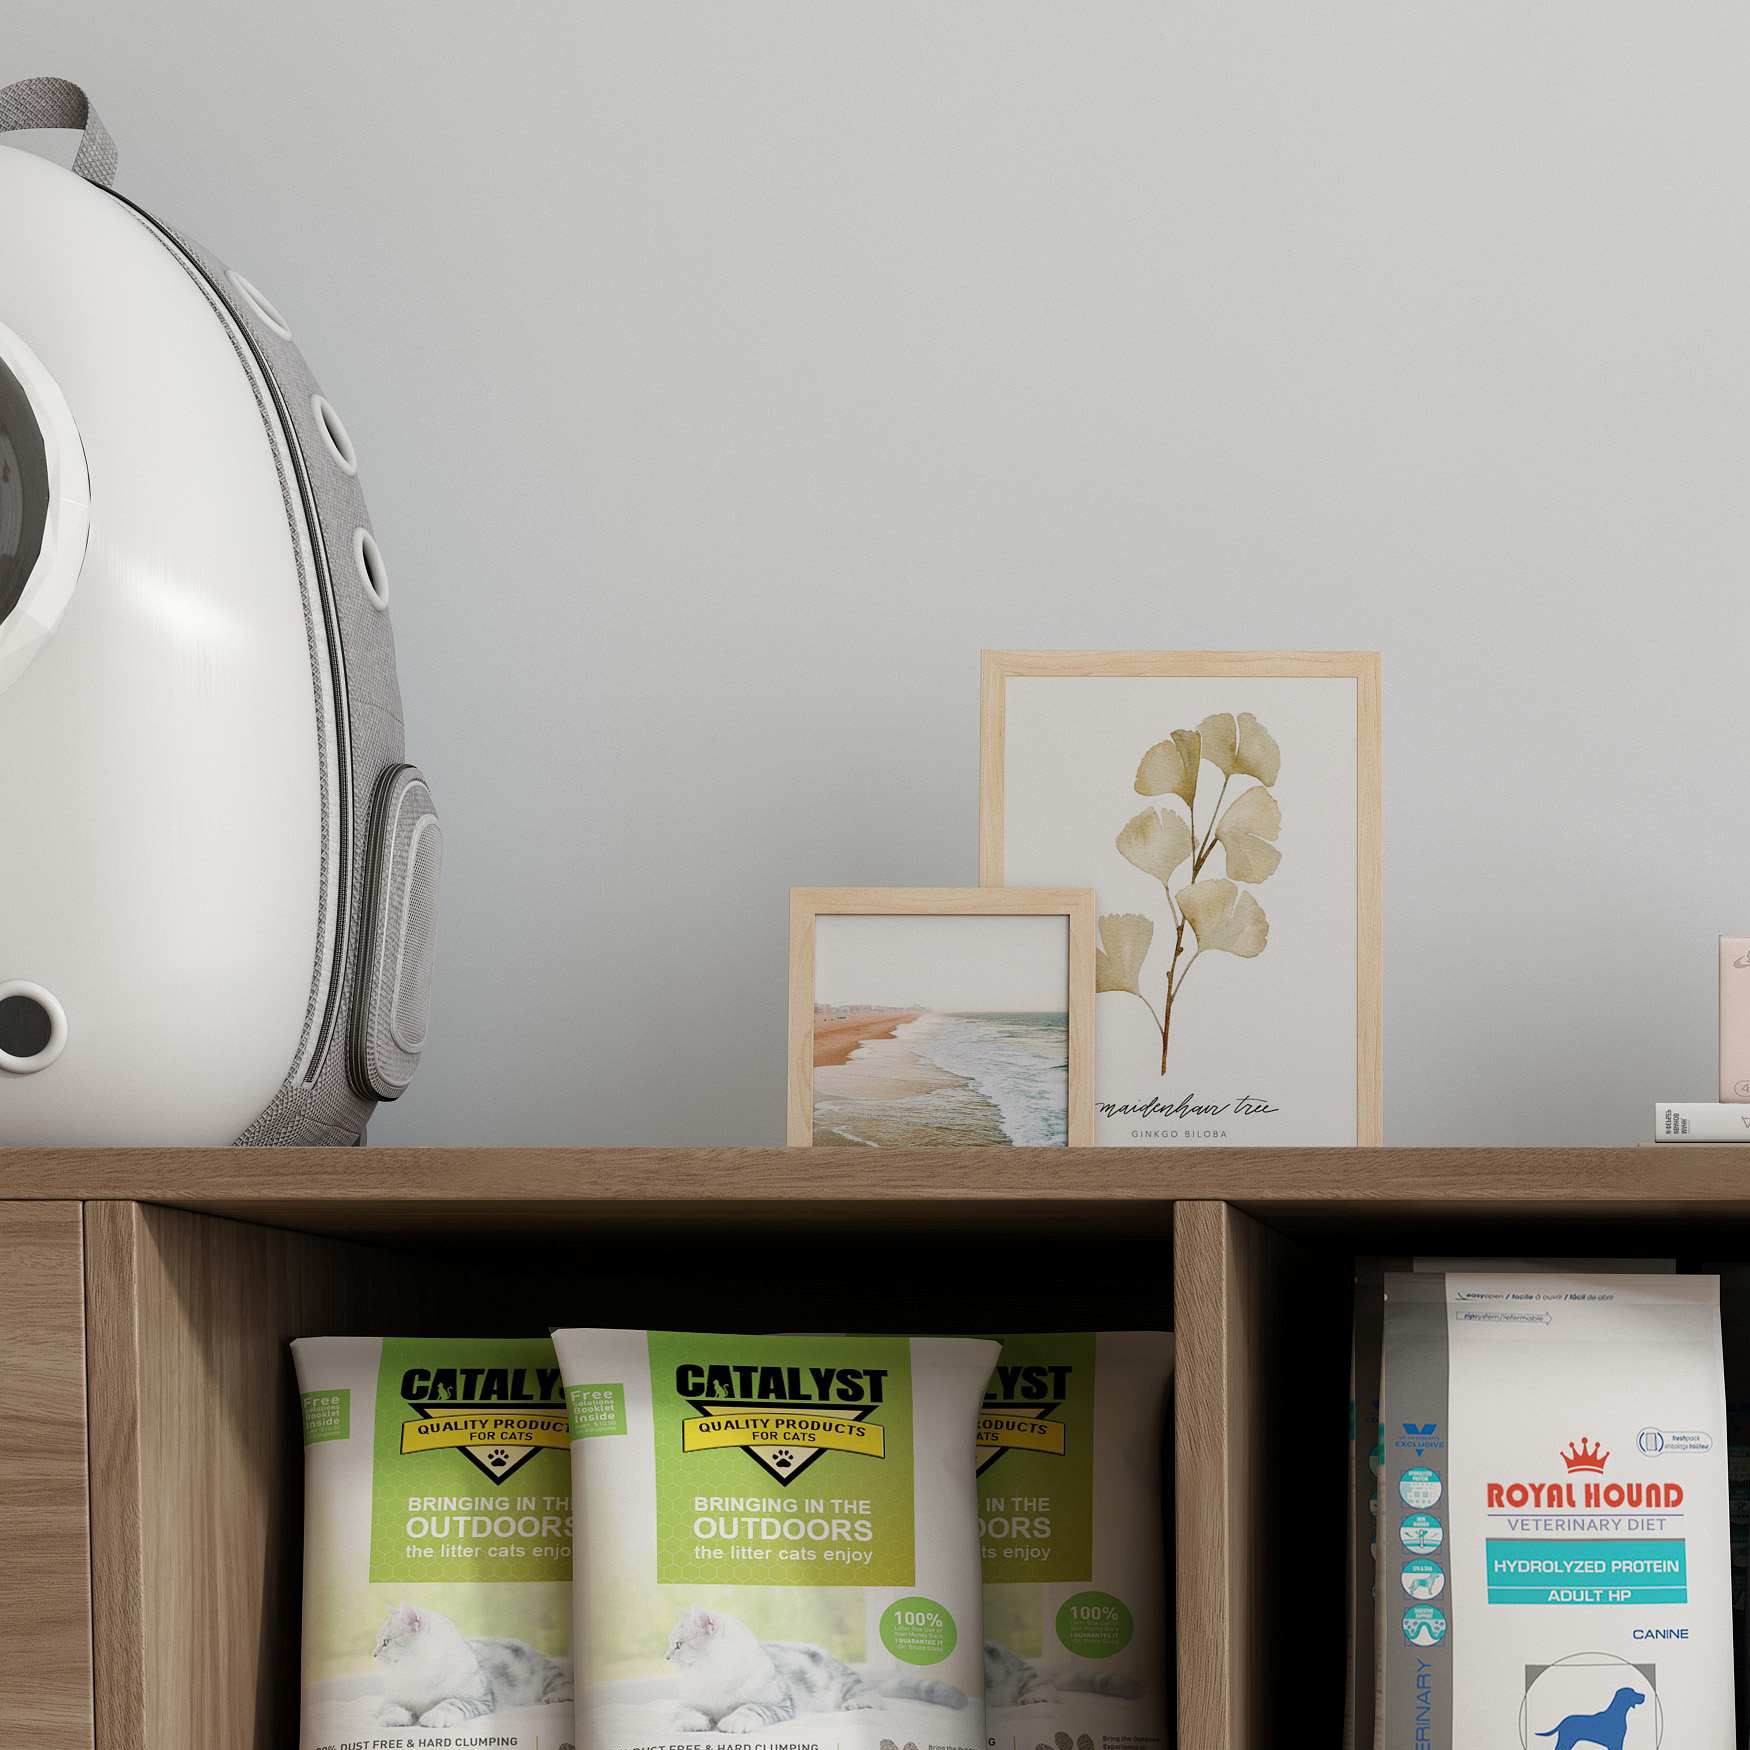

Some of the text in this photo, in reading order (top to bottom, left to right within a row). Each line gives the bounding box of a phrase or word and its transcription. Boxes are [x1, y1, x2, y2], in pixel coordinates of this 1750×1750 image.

[1233, 1095, 1279, 1115] tree
[1131, 1130, 1227, 1138] GINKGO BILOBA
[676, 1364, 888, 1402] CATALYST
[572, 1392, 612, 1401] Free
[576, 1412, 615, 1423] Inside
[699, 1418, 866, 1437] QUALITY PRODUCTS
[752, 1431, 816, 1442] FOR CATS
[1487, 1483, 1684, 1508] ROYAL HOUND
[694, 1497, 872, 1514] BRINGING IN THE
[693, 1517, 873, 1541] OUTDOORS
[1507, 1518, 1666, 1532] VETERINARY DIET
[695, 1546, 873, 1564] the litter cats enjoy
[1494, 1560, 1680, 1574] HYDROLYZED PROTEIN
[1548, 1590, 1632, 1602] ADULT HP
[894, 1611, 942, 1627] 100%
[1632, 1629, 1689, 1640] CANINE
